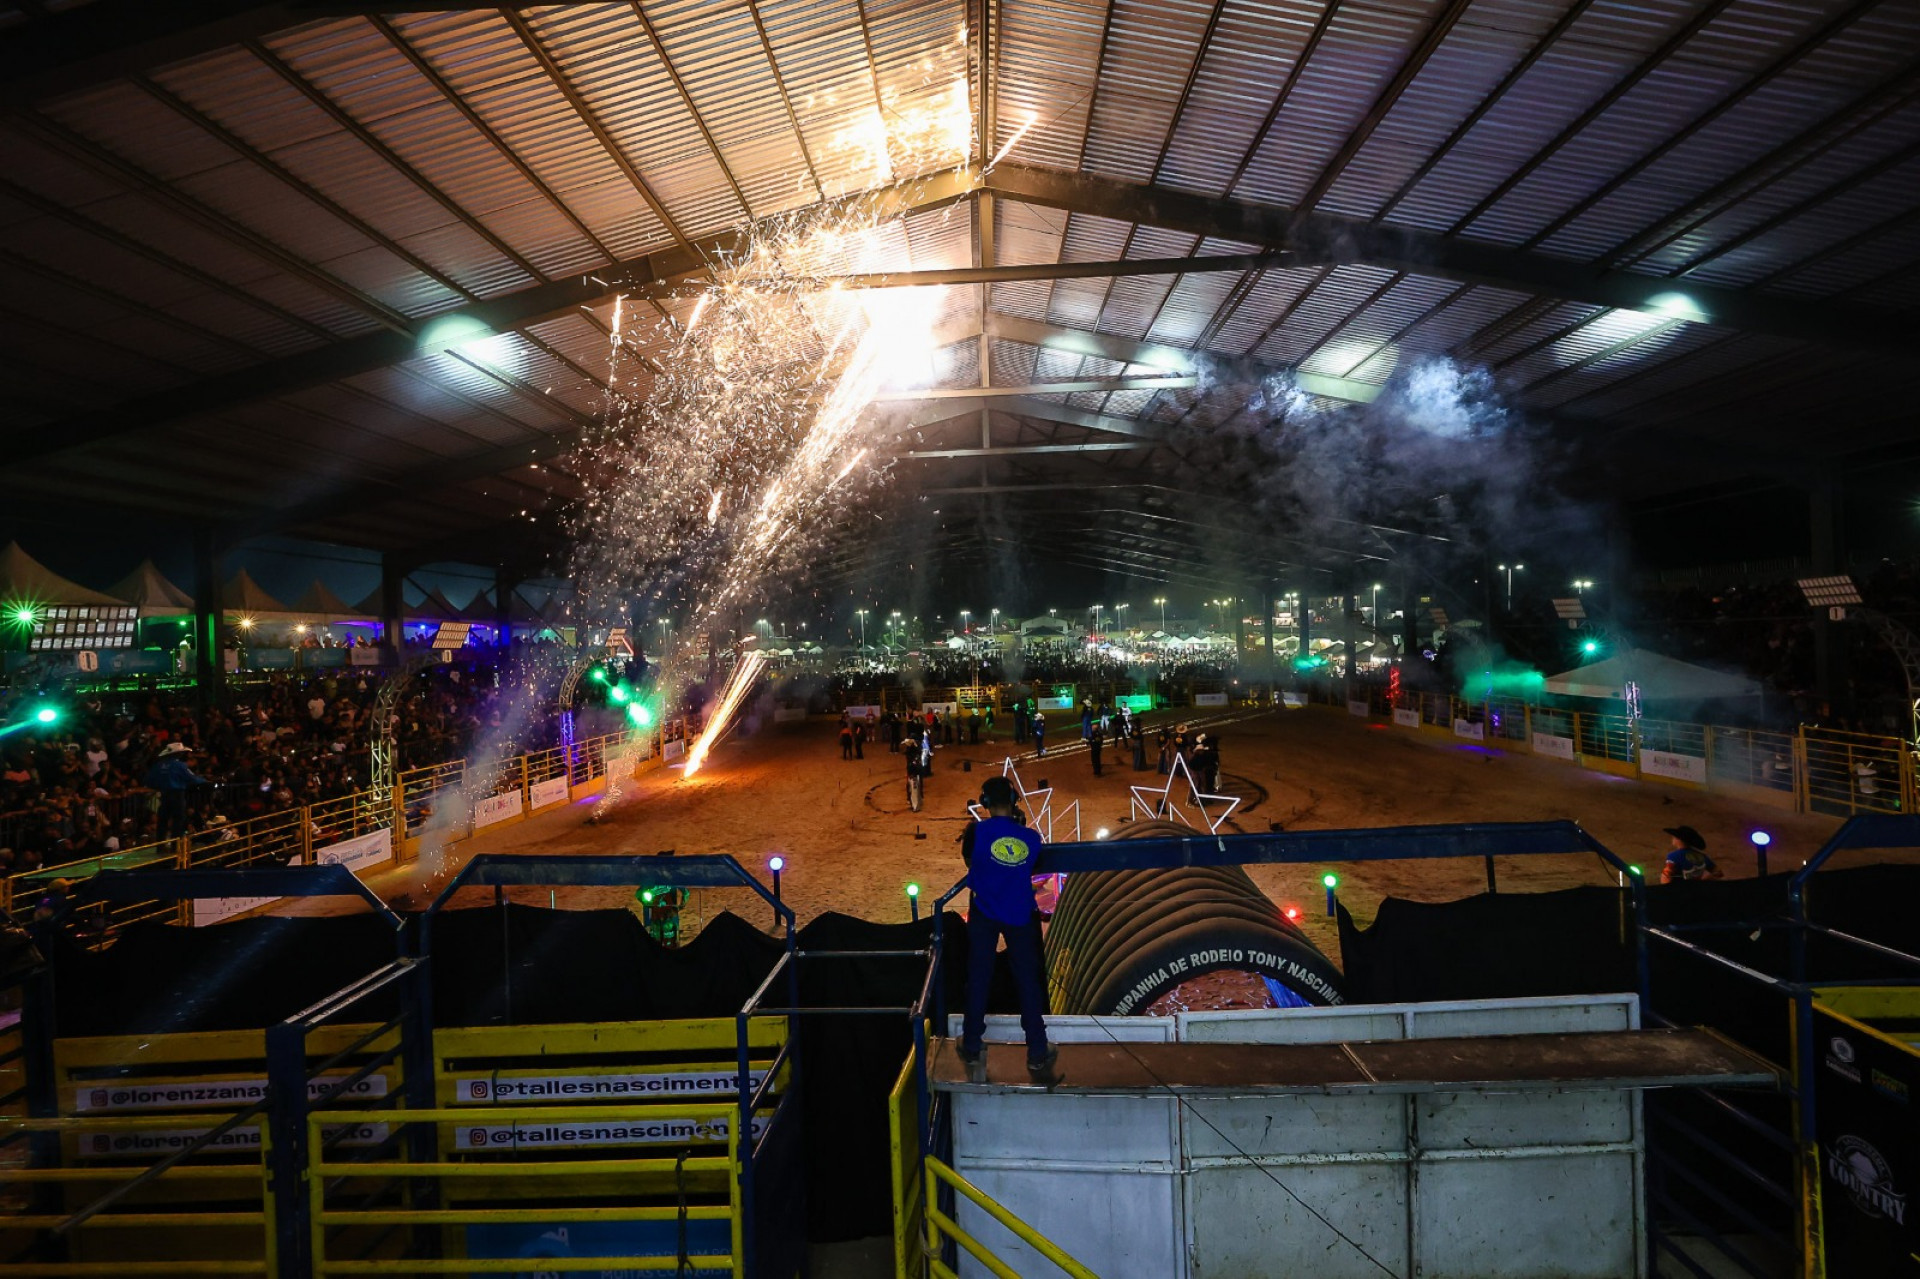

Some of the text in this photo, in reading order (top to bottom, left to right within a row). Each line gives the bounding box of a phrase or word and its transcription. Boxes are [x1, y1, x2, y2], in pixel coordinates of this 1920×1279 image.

[1169, 958, 1188, 975] DE
[1190, 949, 1242, 967] RODEIO
[1248, 950, 1286, 970] TONY
[495, 1077, 760, 1096] @tallesnascimento
[491, 1123, 760, 1143] @tallesnascimeno
[1828, 1157, 1906, 1226] COUNTRY
